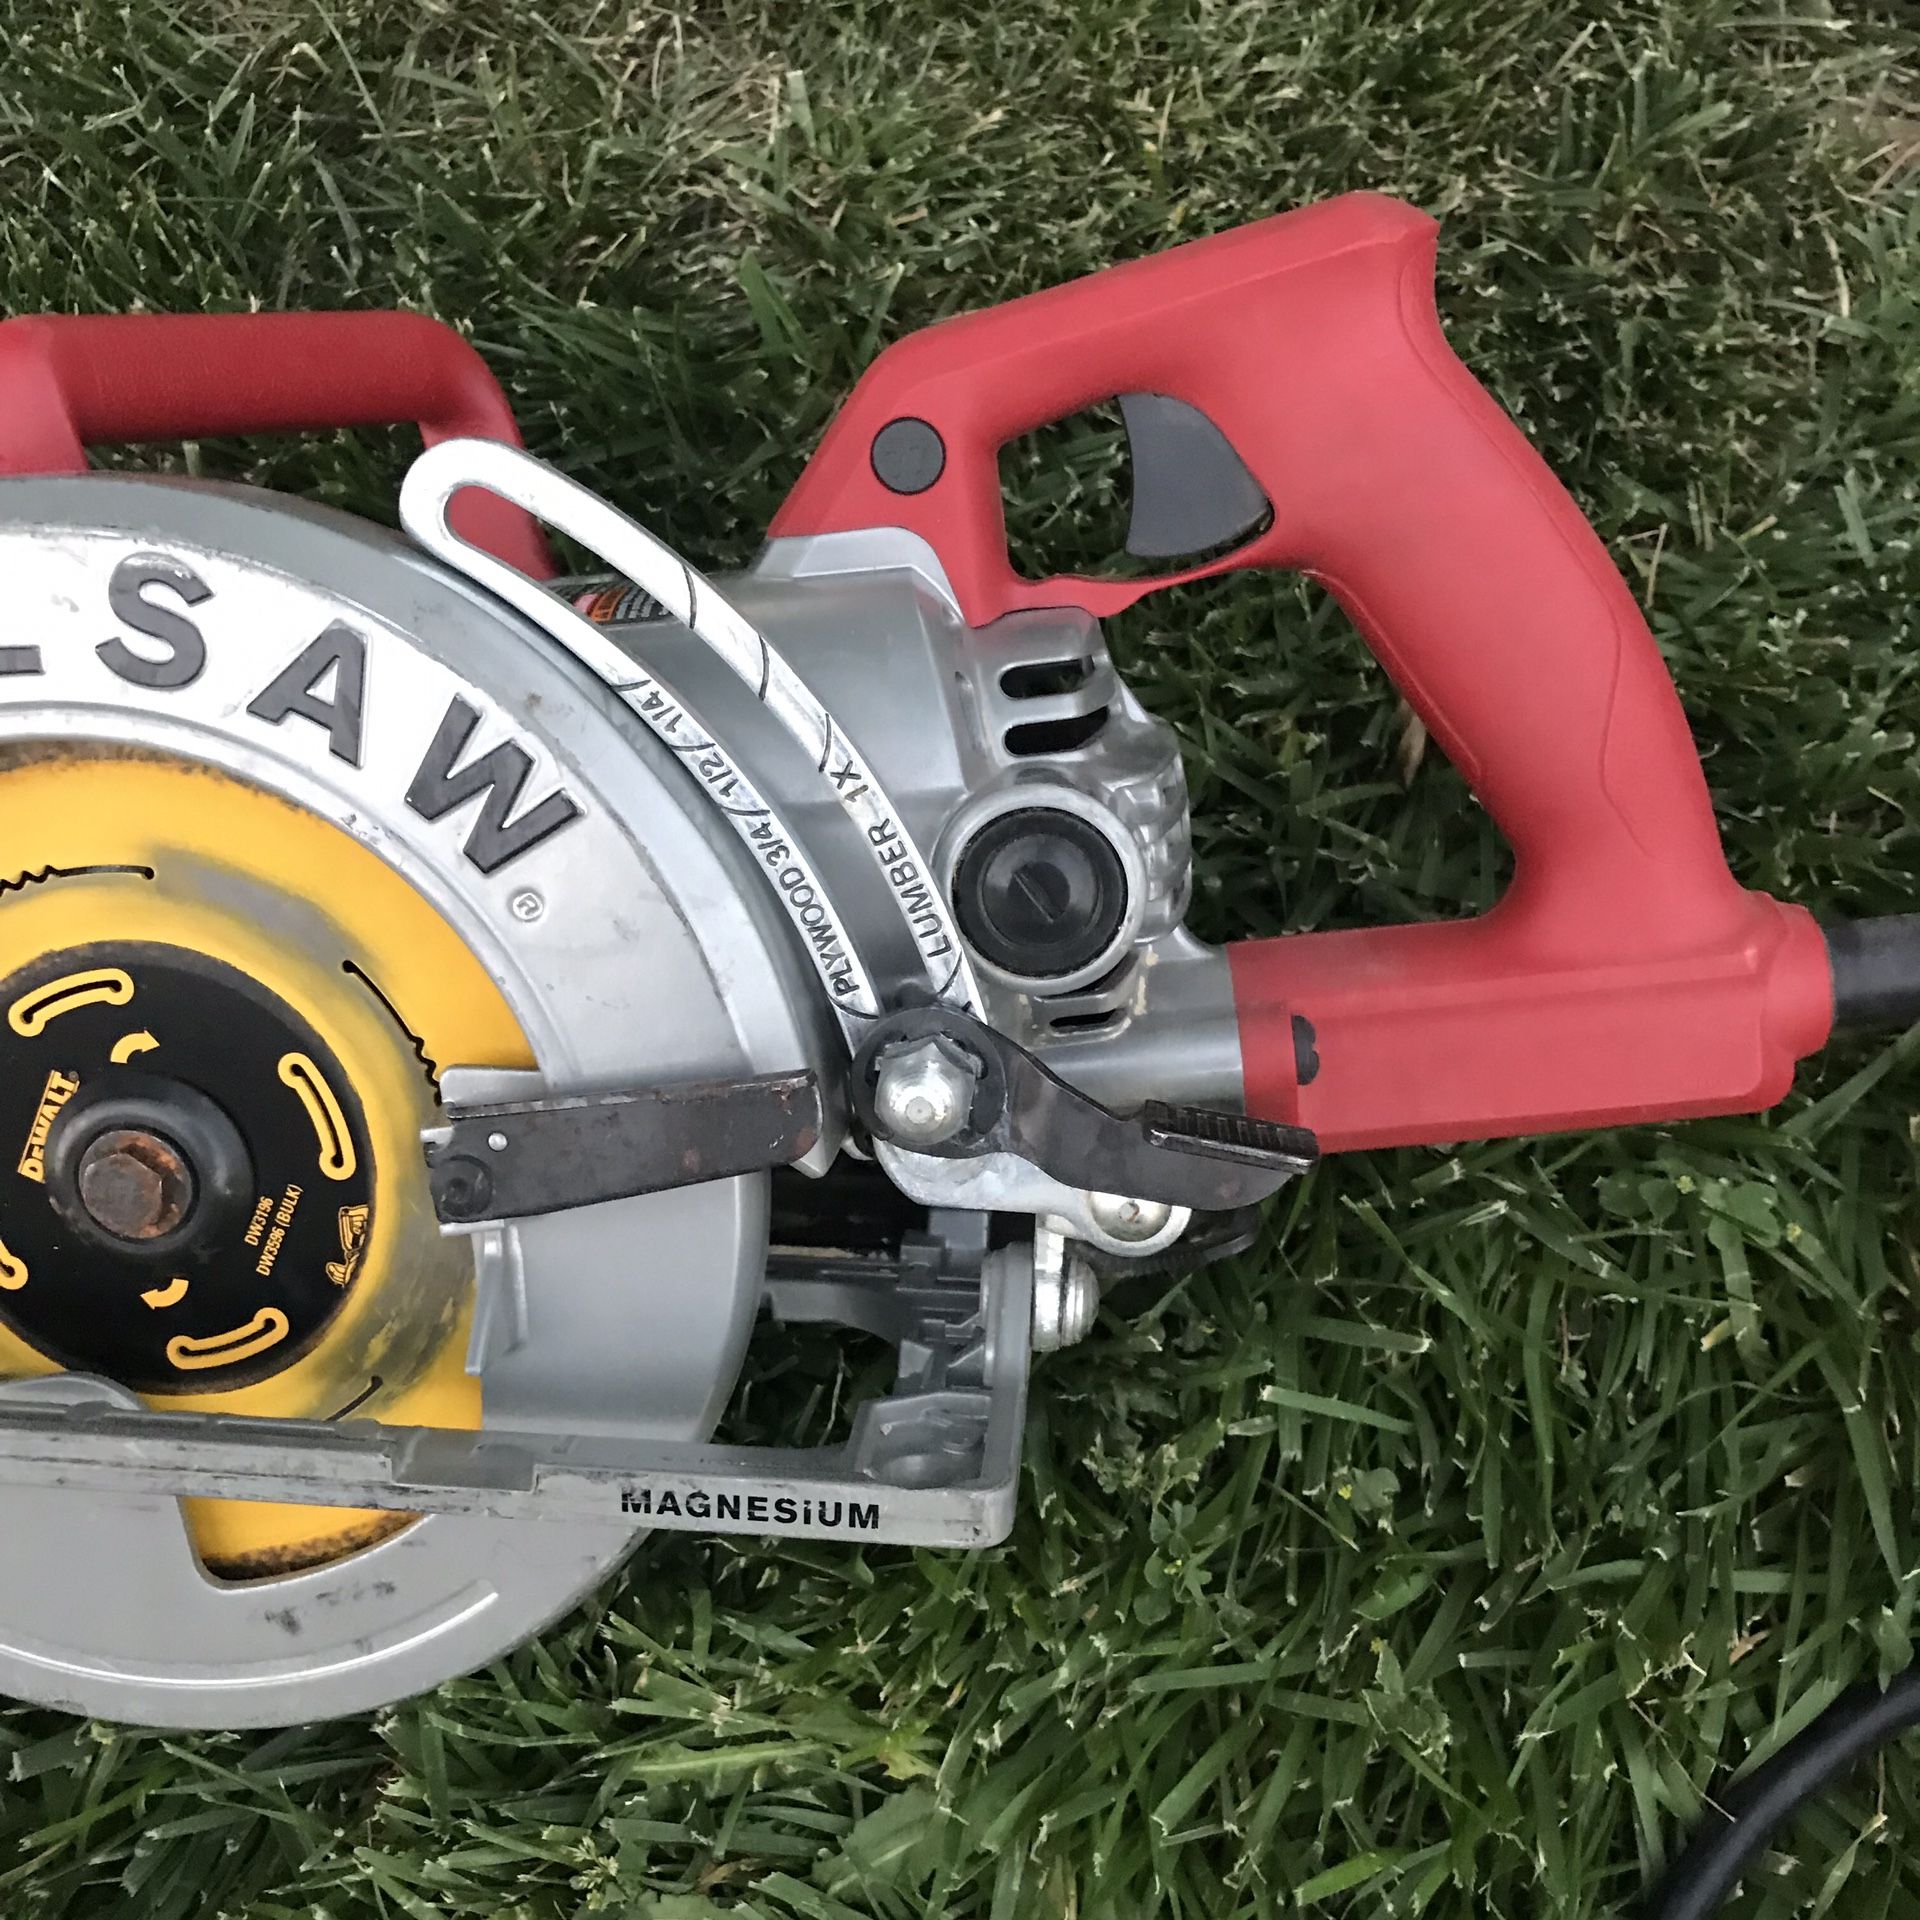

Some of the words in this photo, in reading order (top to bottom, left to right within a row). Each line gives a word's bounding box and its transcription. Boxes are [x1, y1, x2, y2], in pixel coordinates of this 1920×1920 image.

[0, 551, 586, 876] SAW
[640, 691, 683, 733] 1/4
[698, 752, 739, 797] 1/2
[830, 760, 869, 803] 1X
[749, 822, 791, 867] 3/4
[867, 818, 951, 958] LUMBER
[778, 866, 861, 997] PLYWOOD
[17, 1069, 80, 1184] DEWALT
[244, 1196, 274, 1246] DW3196
[256, 1226, 286, 1276] DW3596
[274, 1184, 304, 1228] (BULK)
[621, 1489, 880, 1530] MAGNESIUM
